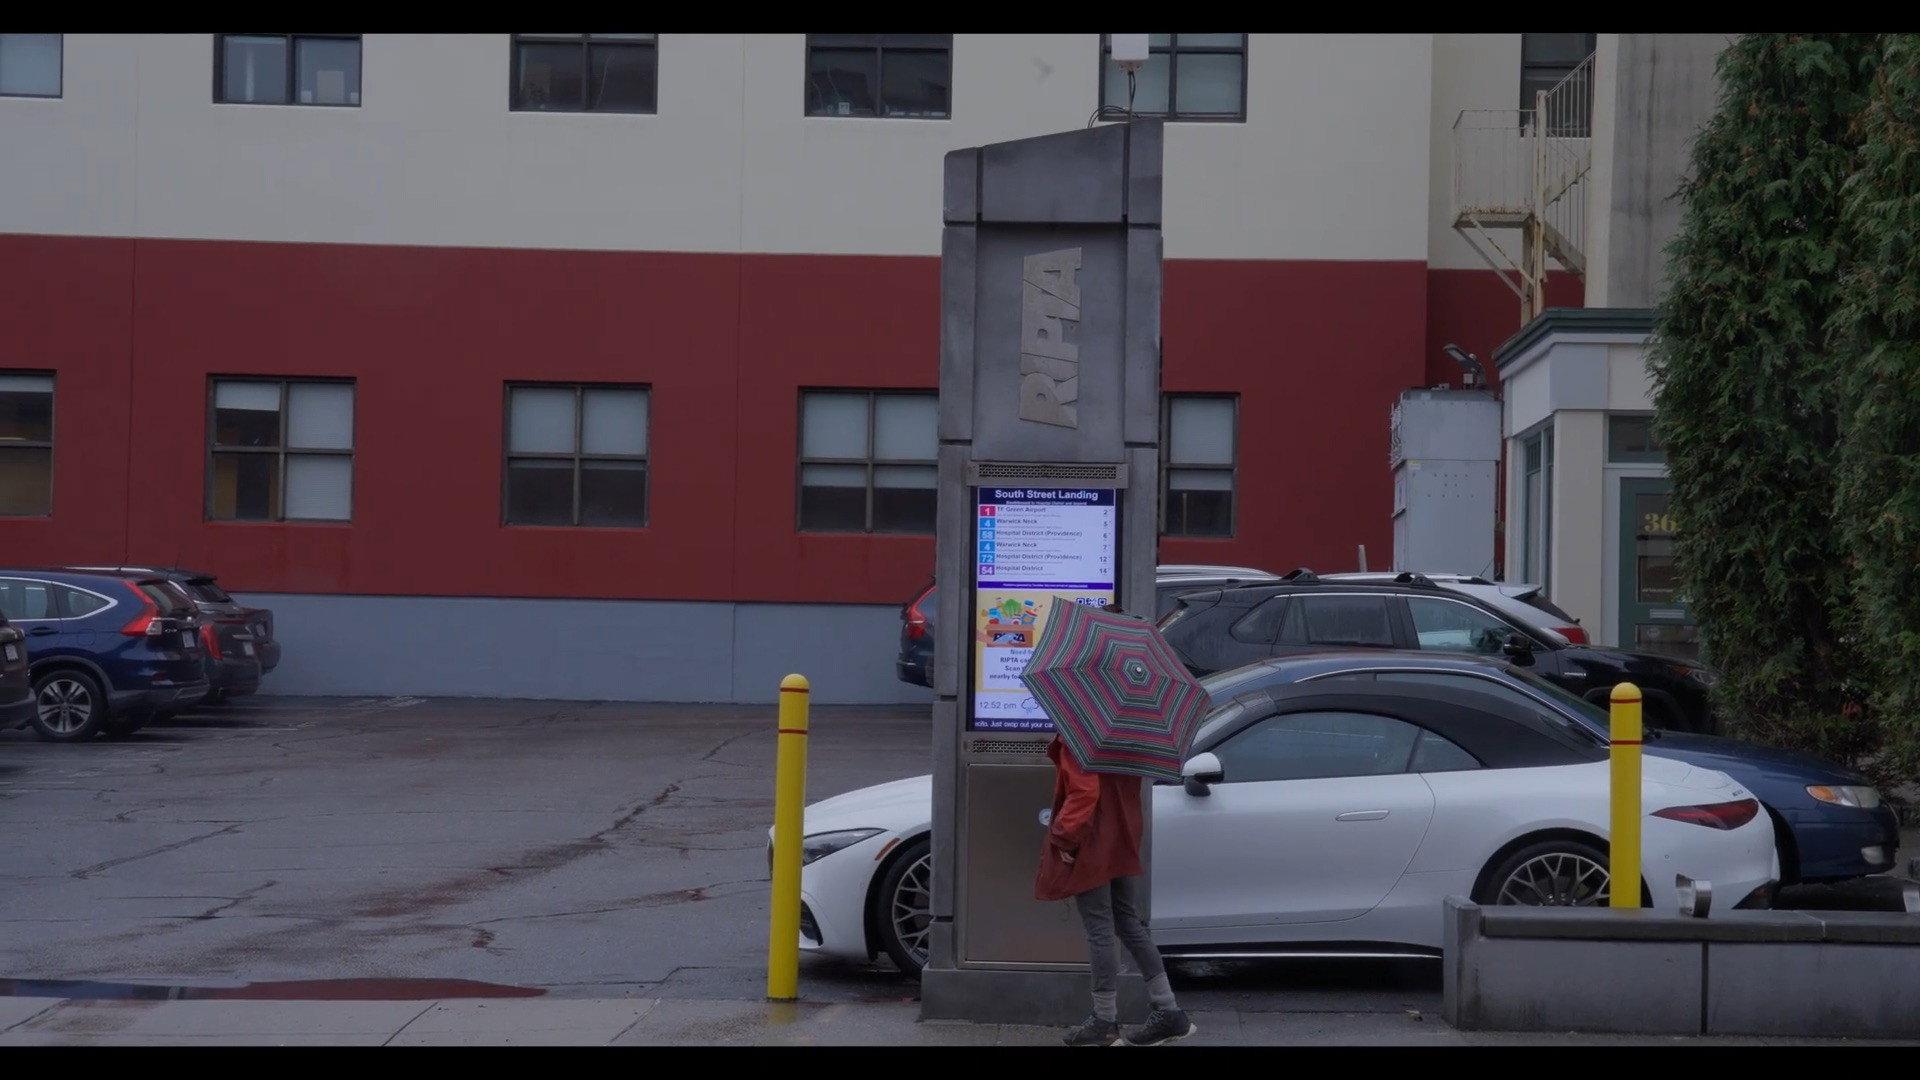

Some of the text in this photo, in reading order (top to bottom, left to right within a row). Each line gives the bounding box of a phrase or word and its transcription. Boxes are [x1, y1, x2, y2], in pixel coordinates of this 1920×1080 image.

[1020, 247, 1082, 429] RIPTA
[995, 490, 1098, 501] South Street Landing
[985, 508, 990, 516] 1
[984, 519, 991, 527] 4
[984, 542, 991, 550] 4
